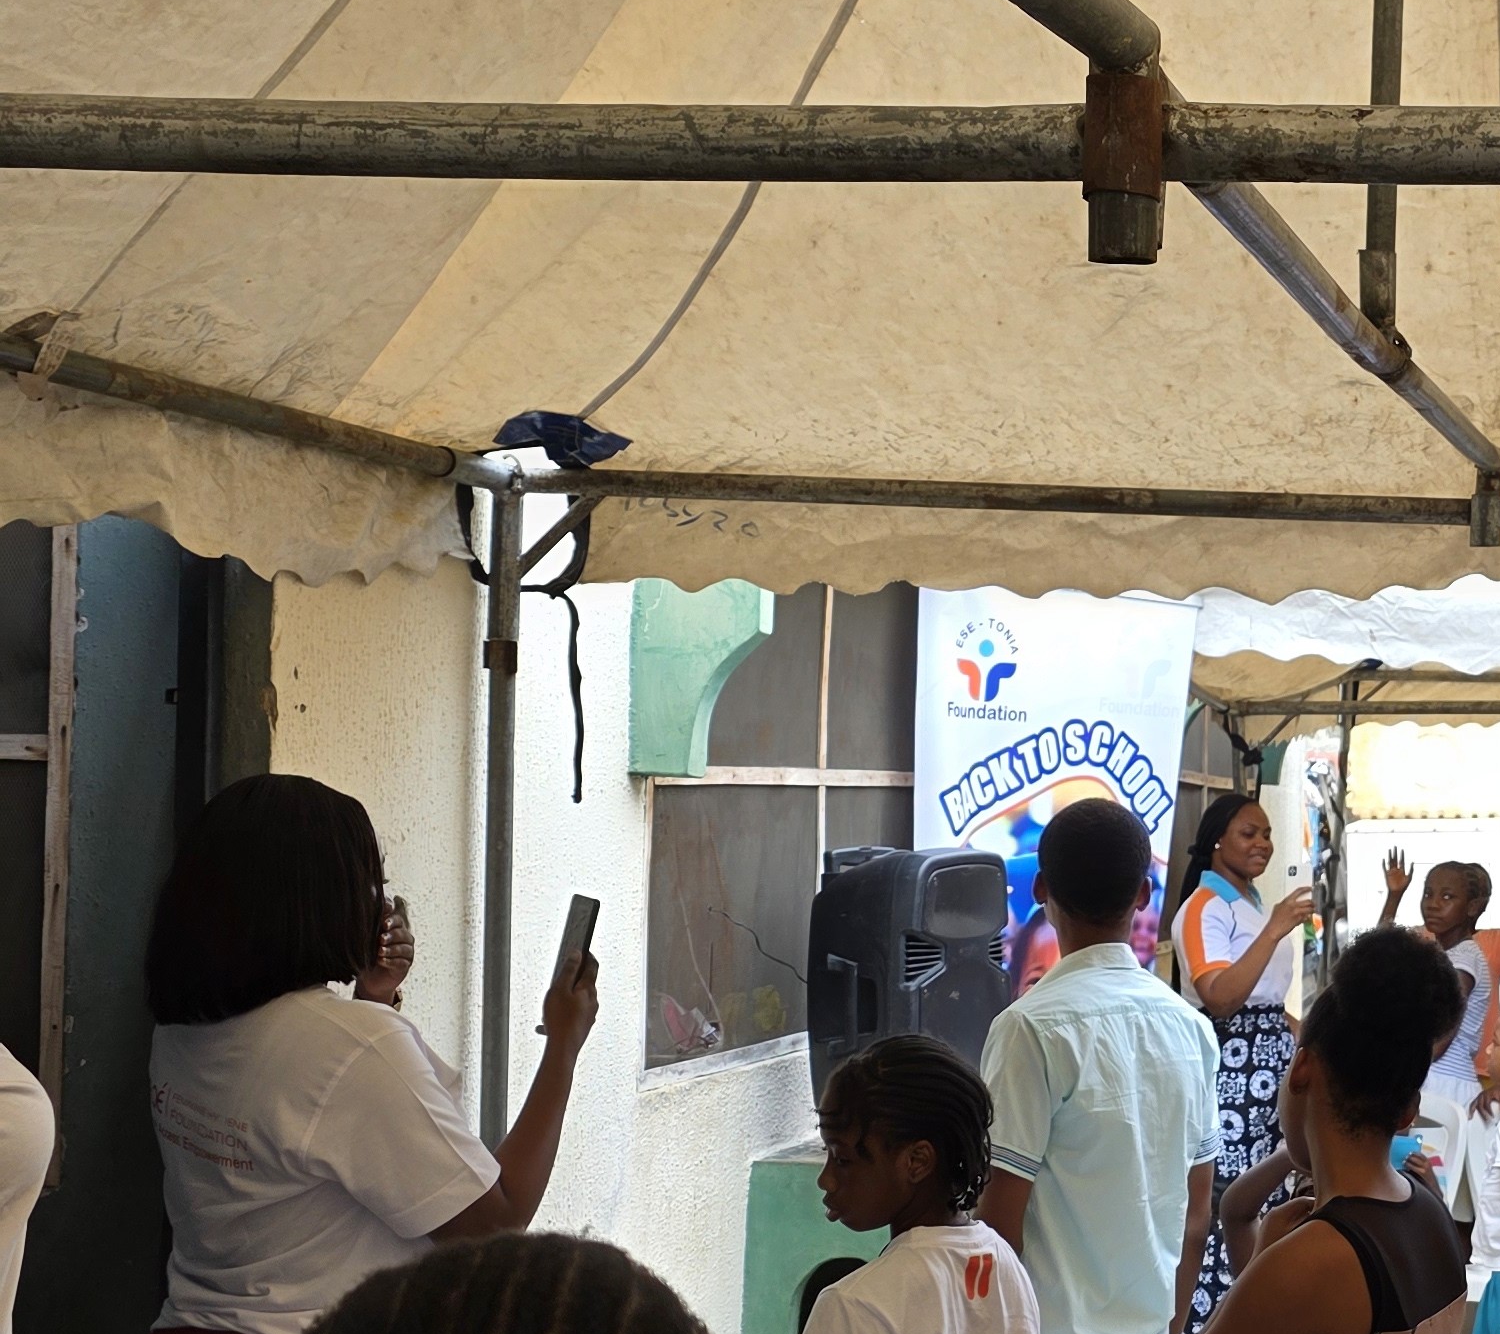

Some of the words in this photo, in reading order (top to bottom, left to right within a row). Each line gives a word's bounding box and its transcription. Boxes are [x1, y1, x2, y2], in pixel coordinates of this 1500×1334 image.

[988, 618, 1019, 655] TONIA
[947, 701, 1027, 723] Foundation
[939, 746, 1025, 836] BACK
[1013, 727, 1061, 784] TO
[1062, 719, 1174, 835] SCHOOL
